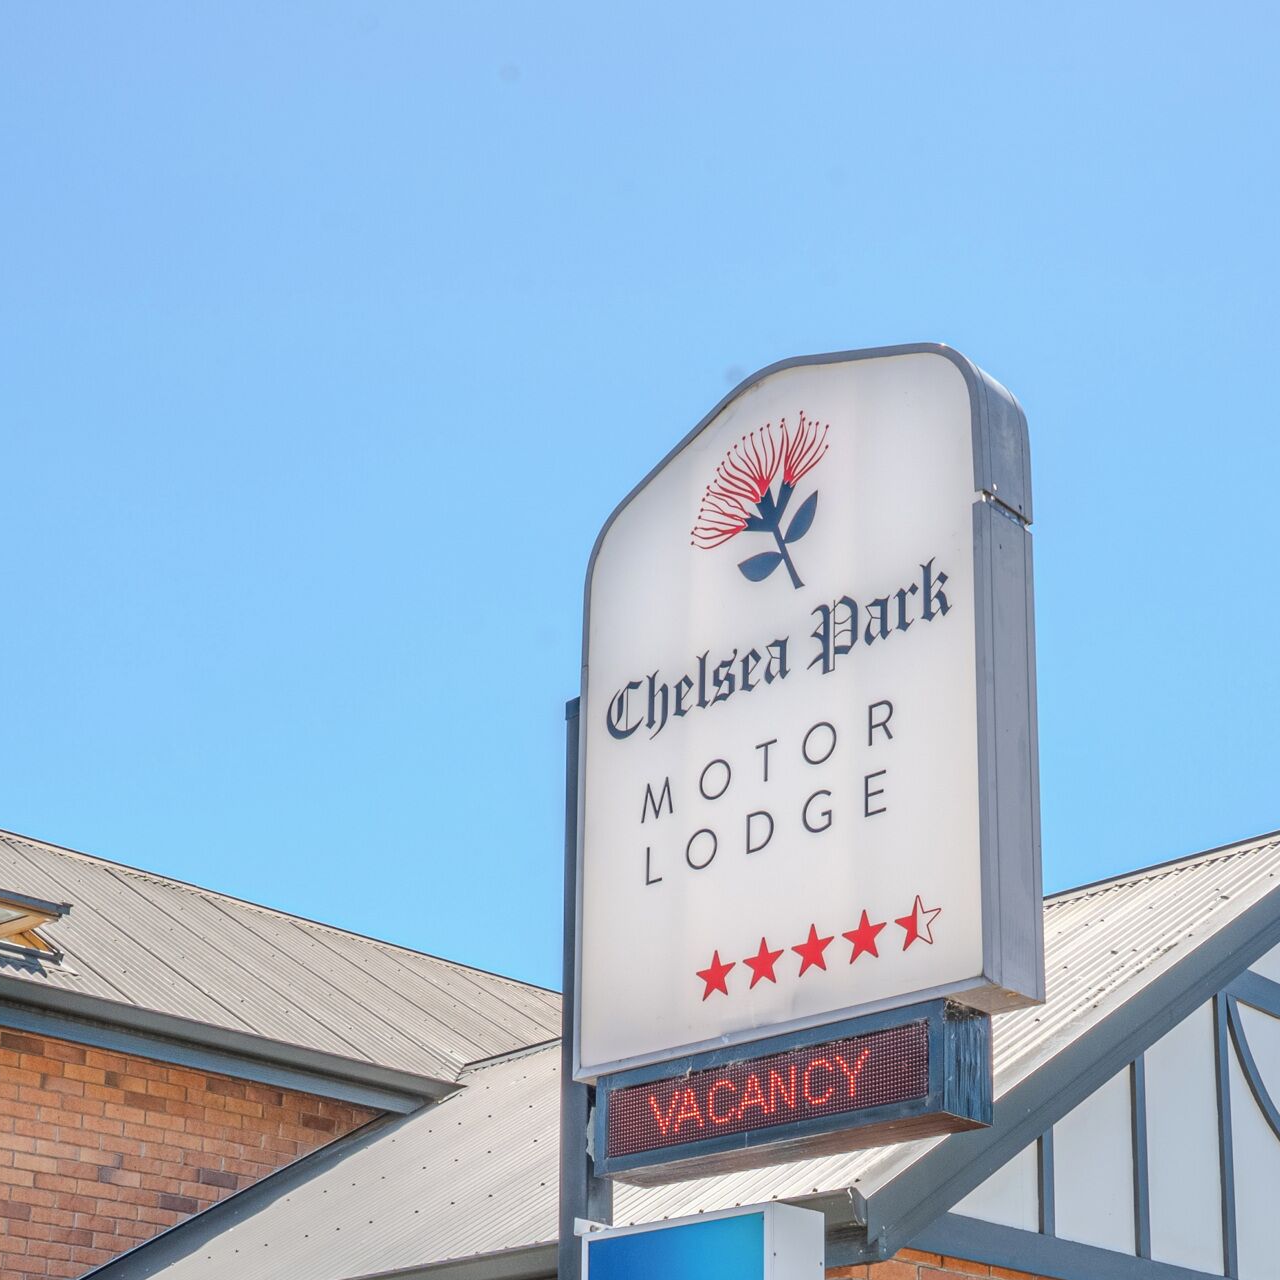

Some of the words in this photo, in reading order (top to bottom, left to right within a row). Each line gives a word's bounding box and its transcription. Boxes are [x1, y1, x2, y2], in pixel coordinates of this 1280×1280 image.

[606, 649, 791, 740] Chelsea
[806, 556, 953, 675] Park
[640, 699, 894, 824] MOTOR
[644, 769, 887, 886] LODGE
[648, 1048, 870, 1136] VACANCY
